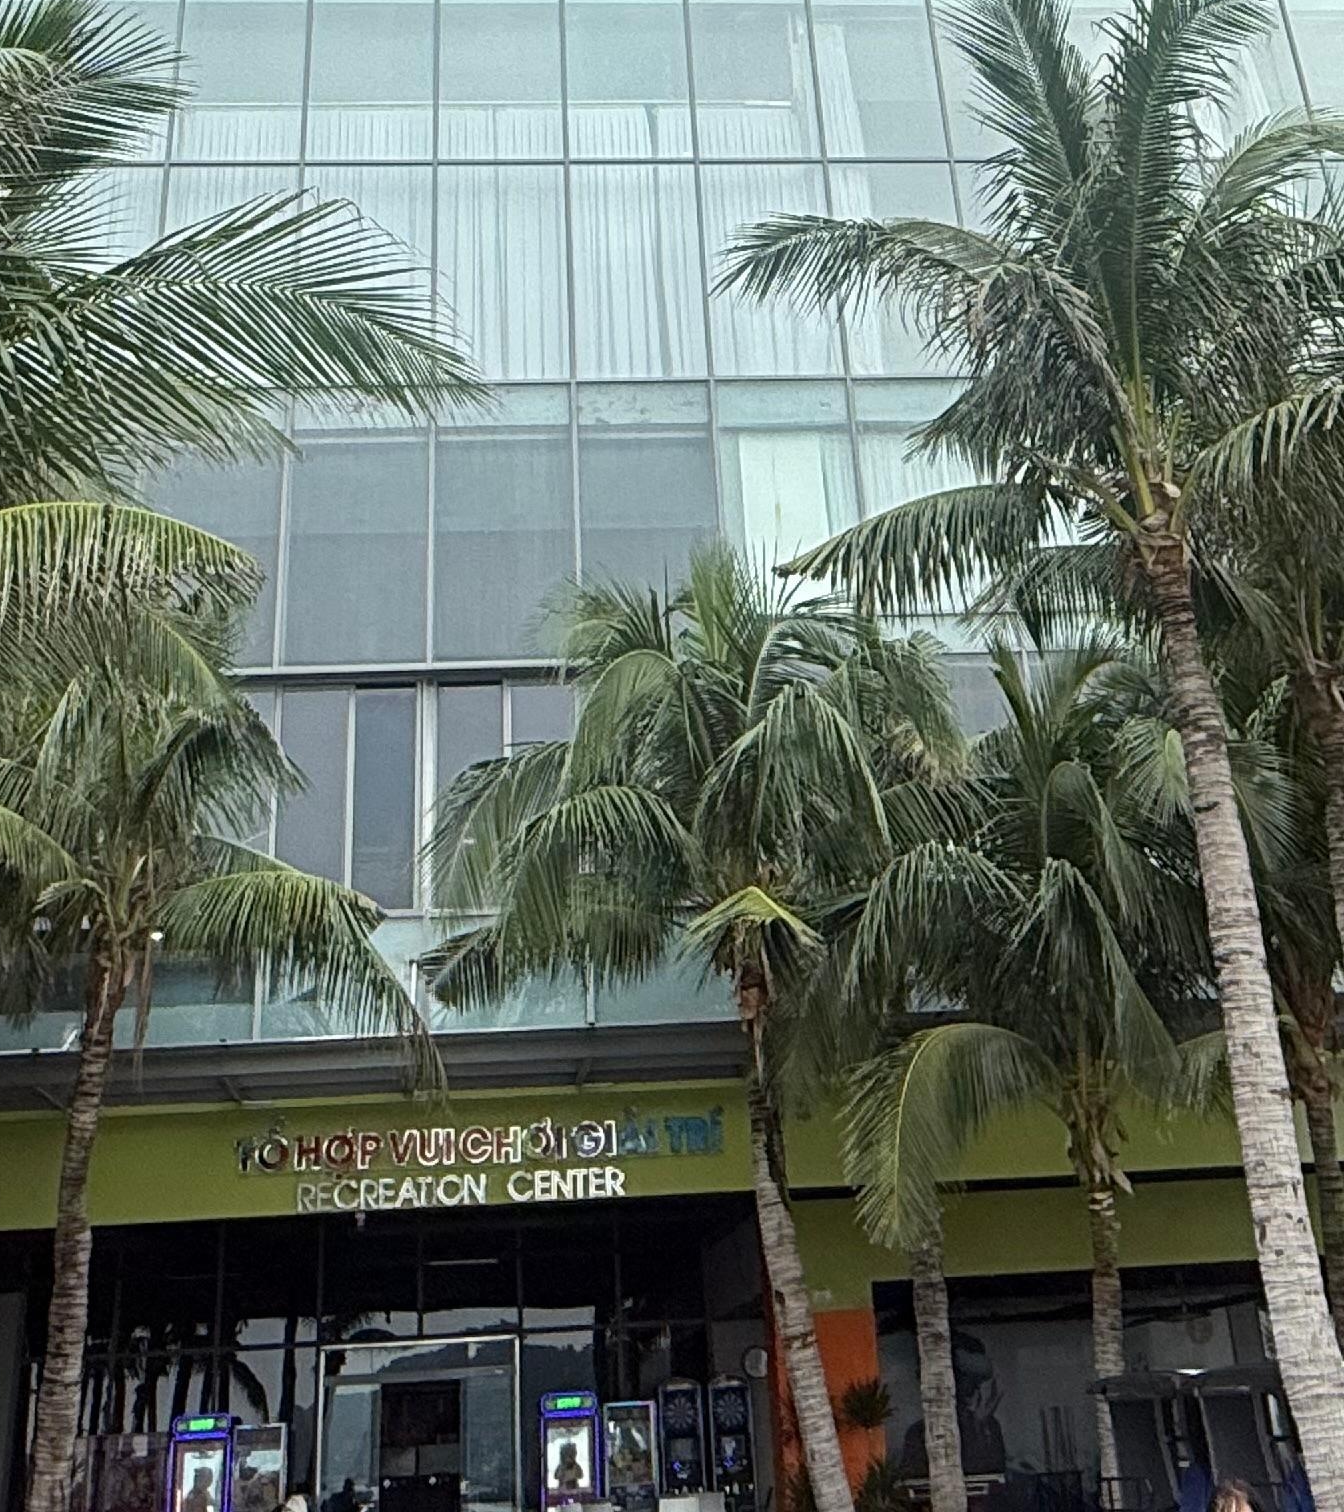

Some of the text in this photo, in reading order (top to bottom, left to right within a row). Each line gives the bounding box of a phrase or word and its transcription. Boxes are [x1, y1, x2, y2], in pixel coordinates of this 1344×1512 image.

[294, 1126, 384, 1179] HỢP
[388, 1128, 456, 1167] VUI
[296, 1165, 627, 1213] RECREATION CENTER
